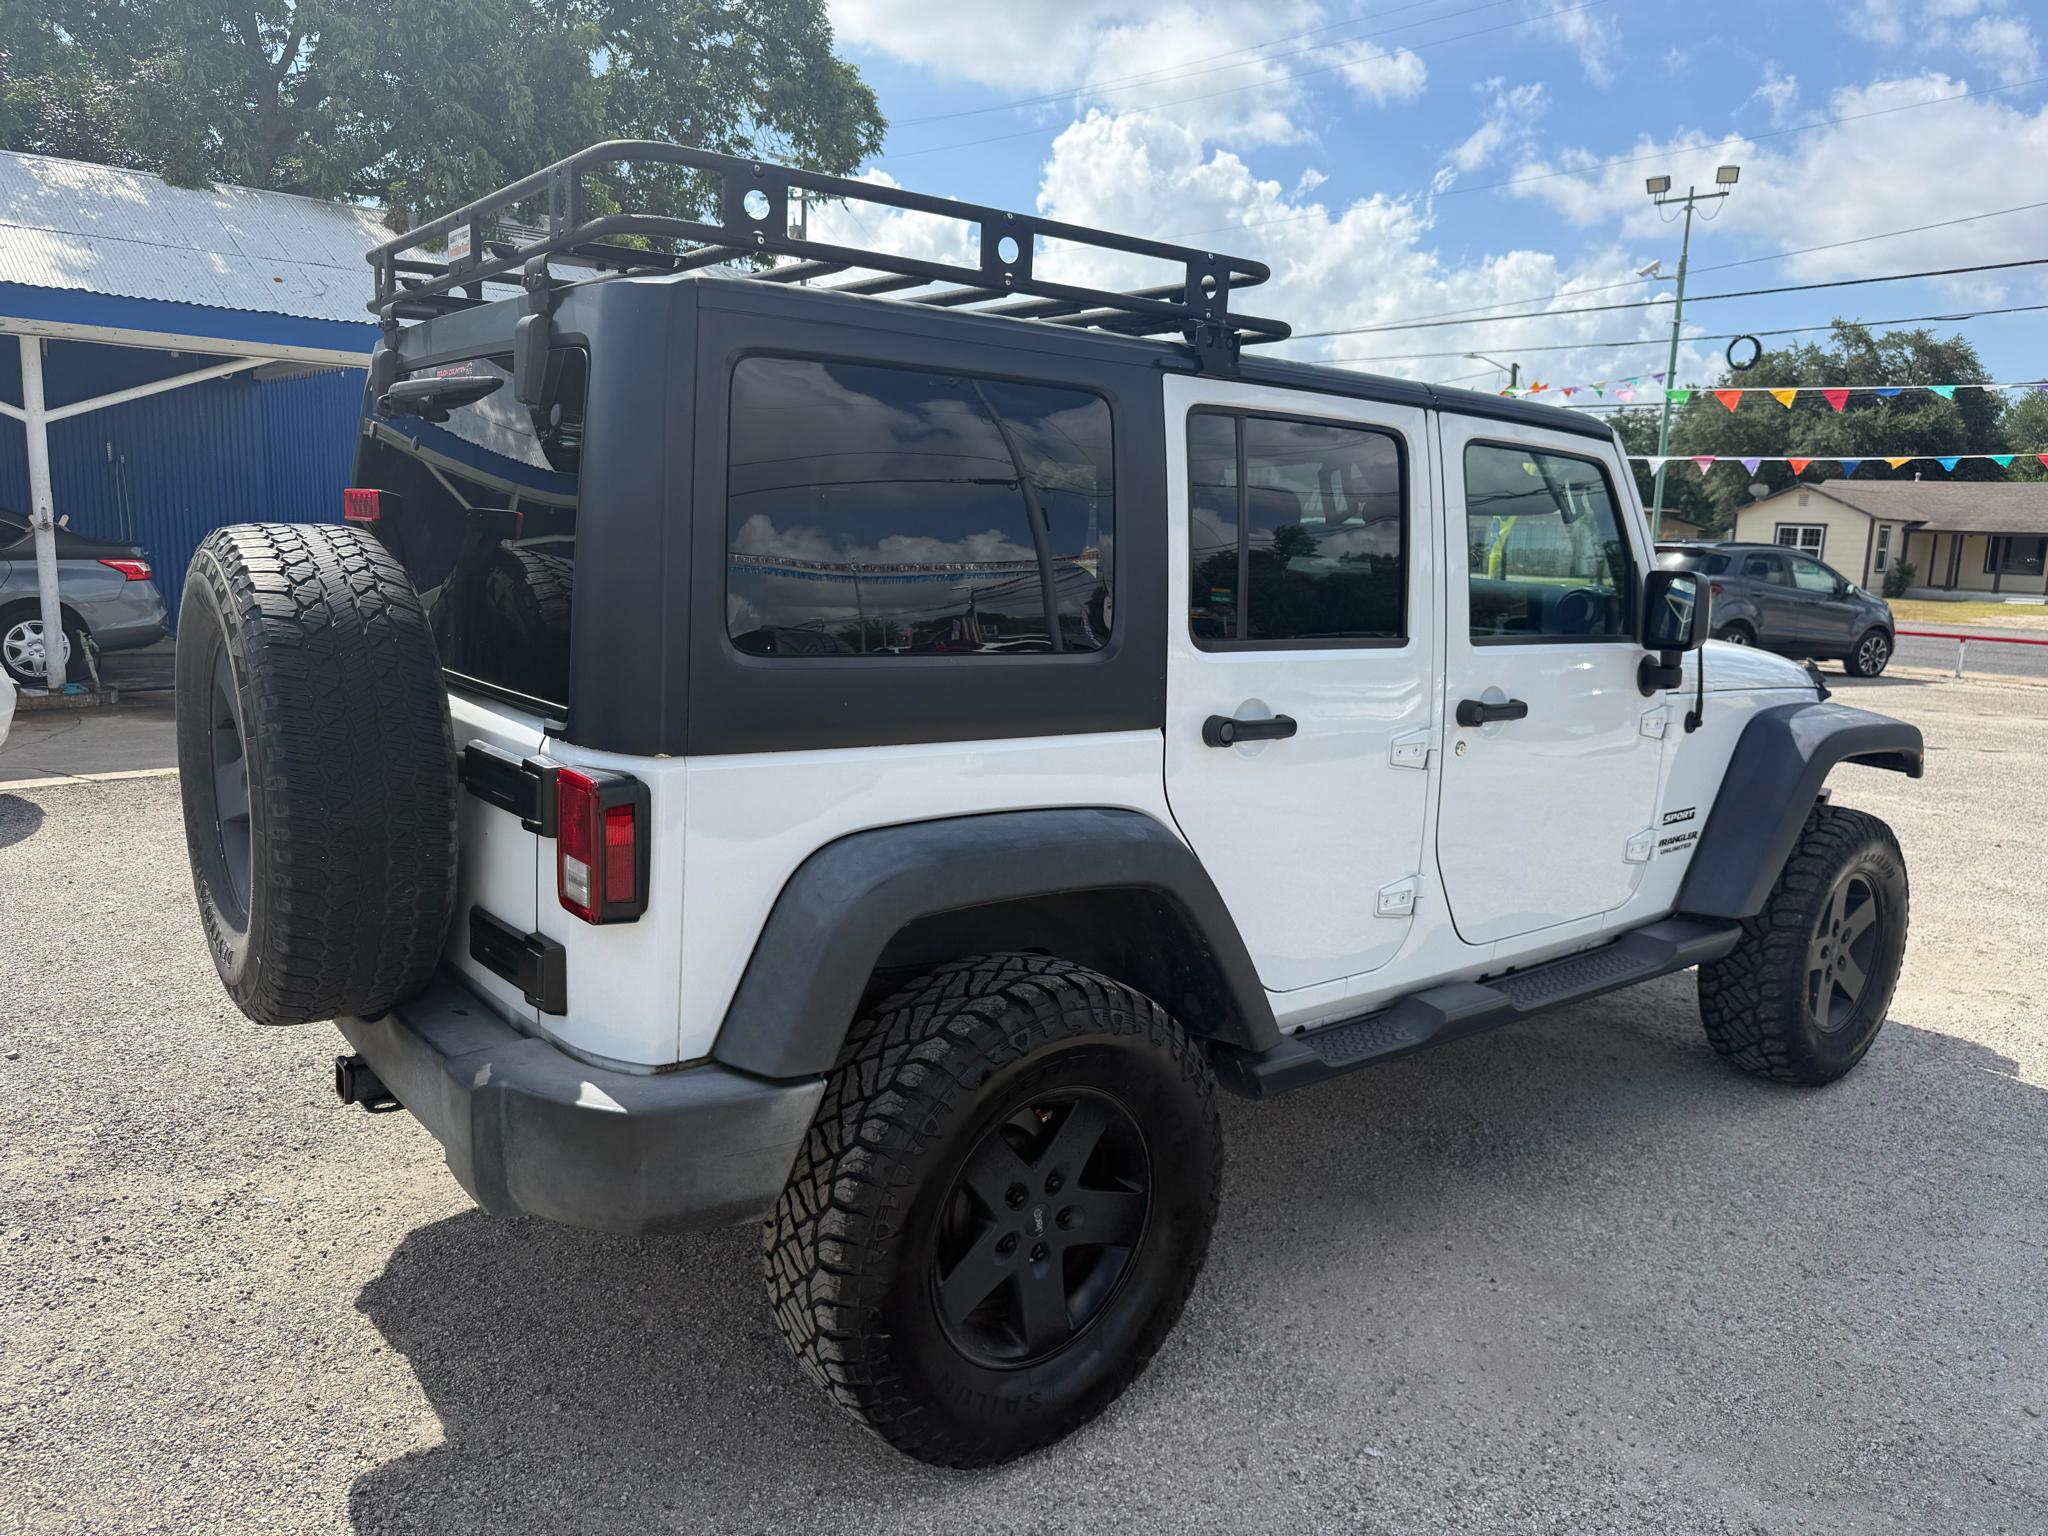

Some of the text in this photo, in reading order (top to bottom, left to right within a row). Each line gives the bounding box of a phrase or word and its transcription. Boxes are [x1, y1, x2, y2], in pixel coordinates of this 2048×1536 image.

[1663, 809, 1695, 823] SPORT
[1660, 842, 1692, 855] UNLIMITED
[936, 1371, 1041, 1416] SAILUN
